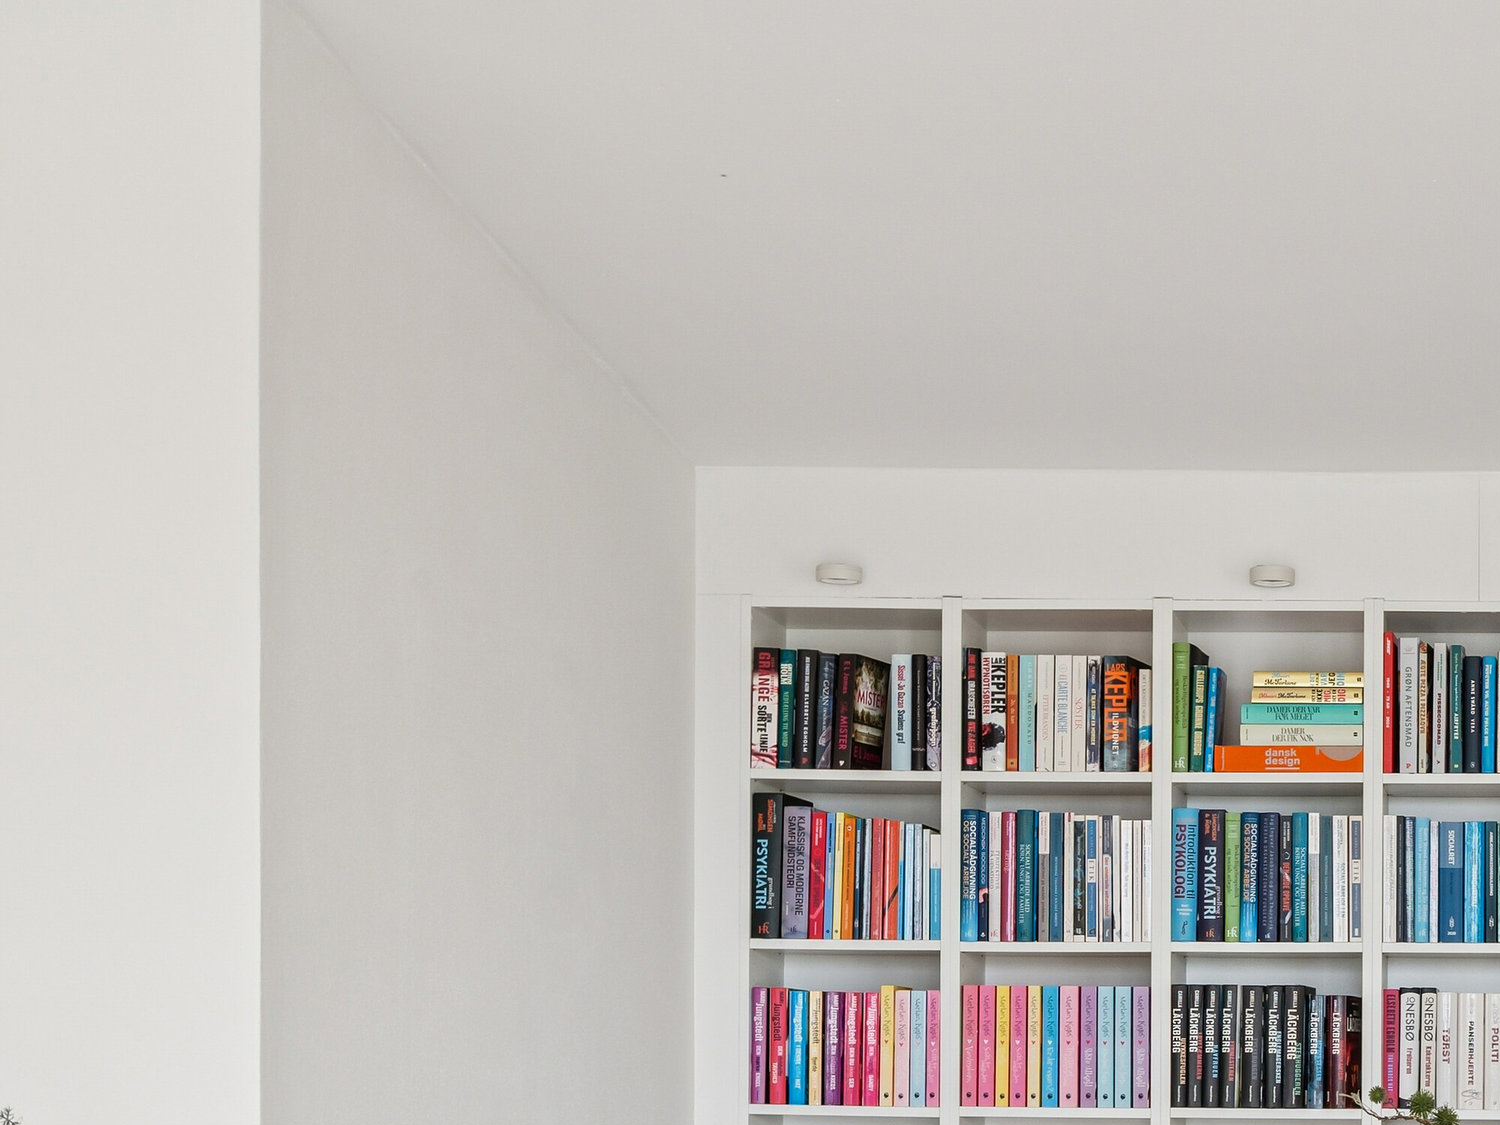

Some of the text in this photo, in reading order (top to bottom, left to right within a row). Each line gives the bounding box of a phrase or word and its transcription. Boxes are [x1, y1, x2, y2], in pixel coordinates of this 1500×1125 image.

[780, 663, 788, 685] HOLM
[983, 657, 991, 715] HYPNOTISØREN
[991, 664, 1006, 714] KEPLER
[757, 705, 769, 733] SORTE
[1104, 671, 1130, 742] KEPLER
[1404, 666, 1413, 748] GRØN AFTENSMAD
[838, 715, 848, 750] MISTER
[1112, 712, 1120, 756] ILDVIDNET
[1265, 748, 1297, 757] dansk
[1265, 757, 1301, 767] design
[786, 815, 796, 889] SAMFUNDSTEORI
[795, 815, 806, 916] KLASSISK OG MODERNE
[969, 820, 979, 900] SOCIALRÅDGIVNING
[1174, 823, 1187, 899] PSYKOLOGI
[1187, 823, 1197, 899] Introduktion til
[1448, 829, 1456, 866] SOCIALRET
[756, 838, 769, 909] PSYKIATRI
[1203, 845, 1217, 920] PSYKIATRI
[755, 1002, 767, 1042] Jungstedt
[773, 1002, 784, 1042] Jungstedt
[867, 1007, 878, 1046] Jungstedt
[1172, 1008, 1185, 1054] LÄCKBERG
[1268, 1009, 1281, 1055] LÄCKBERG
[1287, 1009, 1300, 1061] LÄCKBERG
[1424, 1003, 1435, 1042] NESBØ
[1491, 1027, 1500, 1063] POLITI
[1442, 1028, 1451, 1064] TØRST
[1467, 1020, 1475, 1086] PANSERHJERTE
